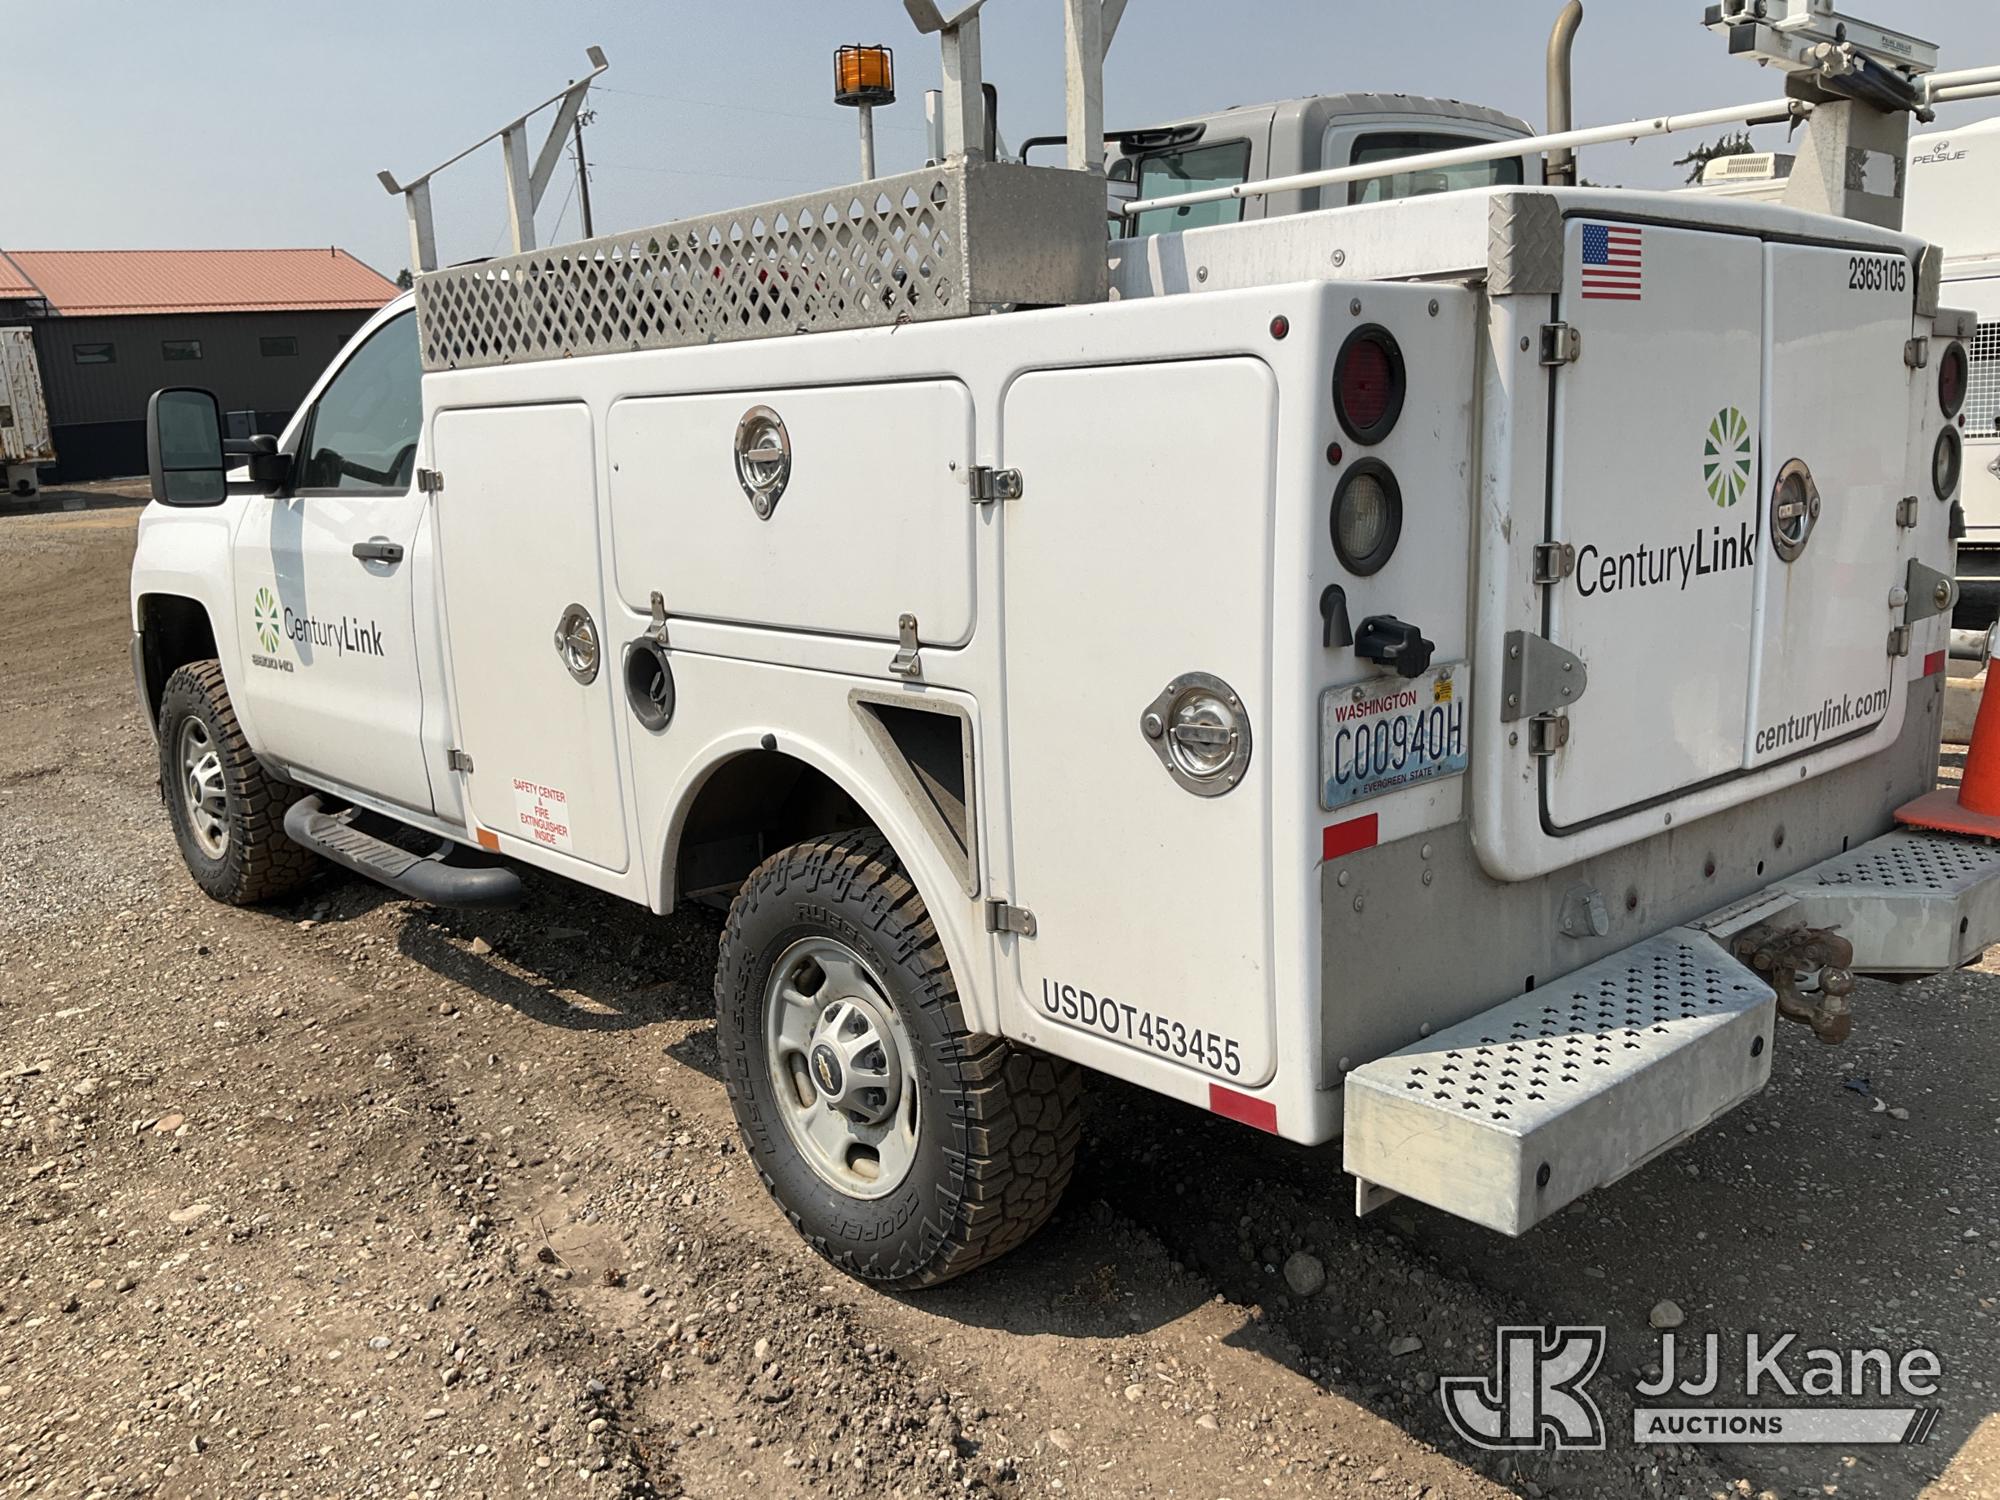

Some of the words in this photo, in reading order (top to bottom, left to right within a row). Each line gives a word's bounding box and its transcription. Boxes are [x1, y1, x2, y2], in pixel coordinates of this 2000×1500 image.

[1912, 150, 1969, 165] PELSUE
[1849, 257, 1906, 292] 2363105
[1576, 522, 1754, 597] CenturyLink
[284, 607, 385, 657] CenturyLink
[1335, 690, 1417, 723] WASHINGTON
[1755, 688, 1887, 754] centurylink.com
[513, 778, 537, 794] SAFETY
[538, 786, 566, 803] CENTER
[1363, 776, 1407, 794] EVERGREEN
[1410, 766, 1433, 781] STATE
[520, 813, 568, 837] EXTINGUISHER
[534, 806, 550, 820] FIRE
[534, 828, 556, 845] INSIDE
[1042, 977, 1241, 1076] USDOT453455
